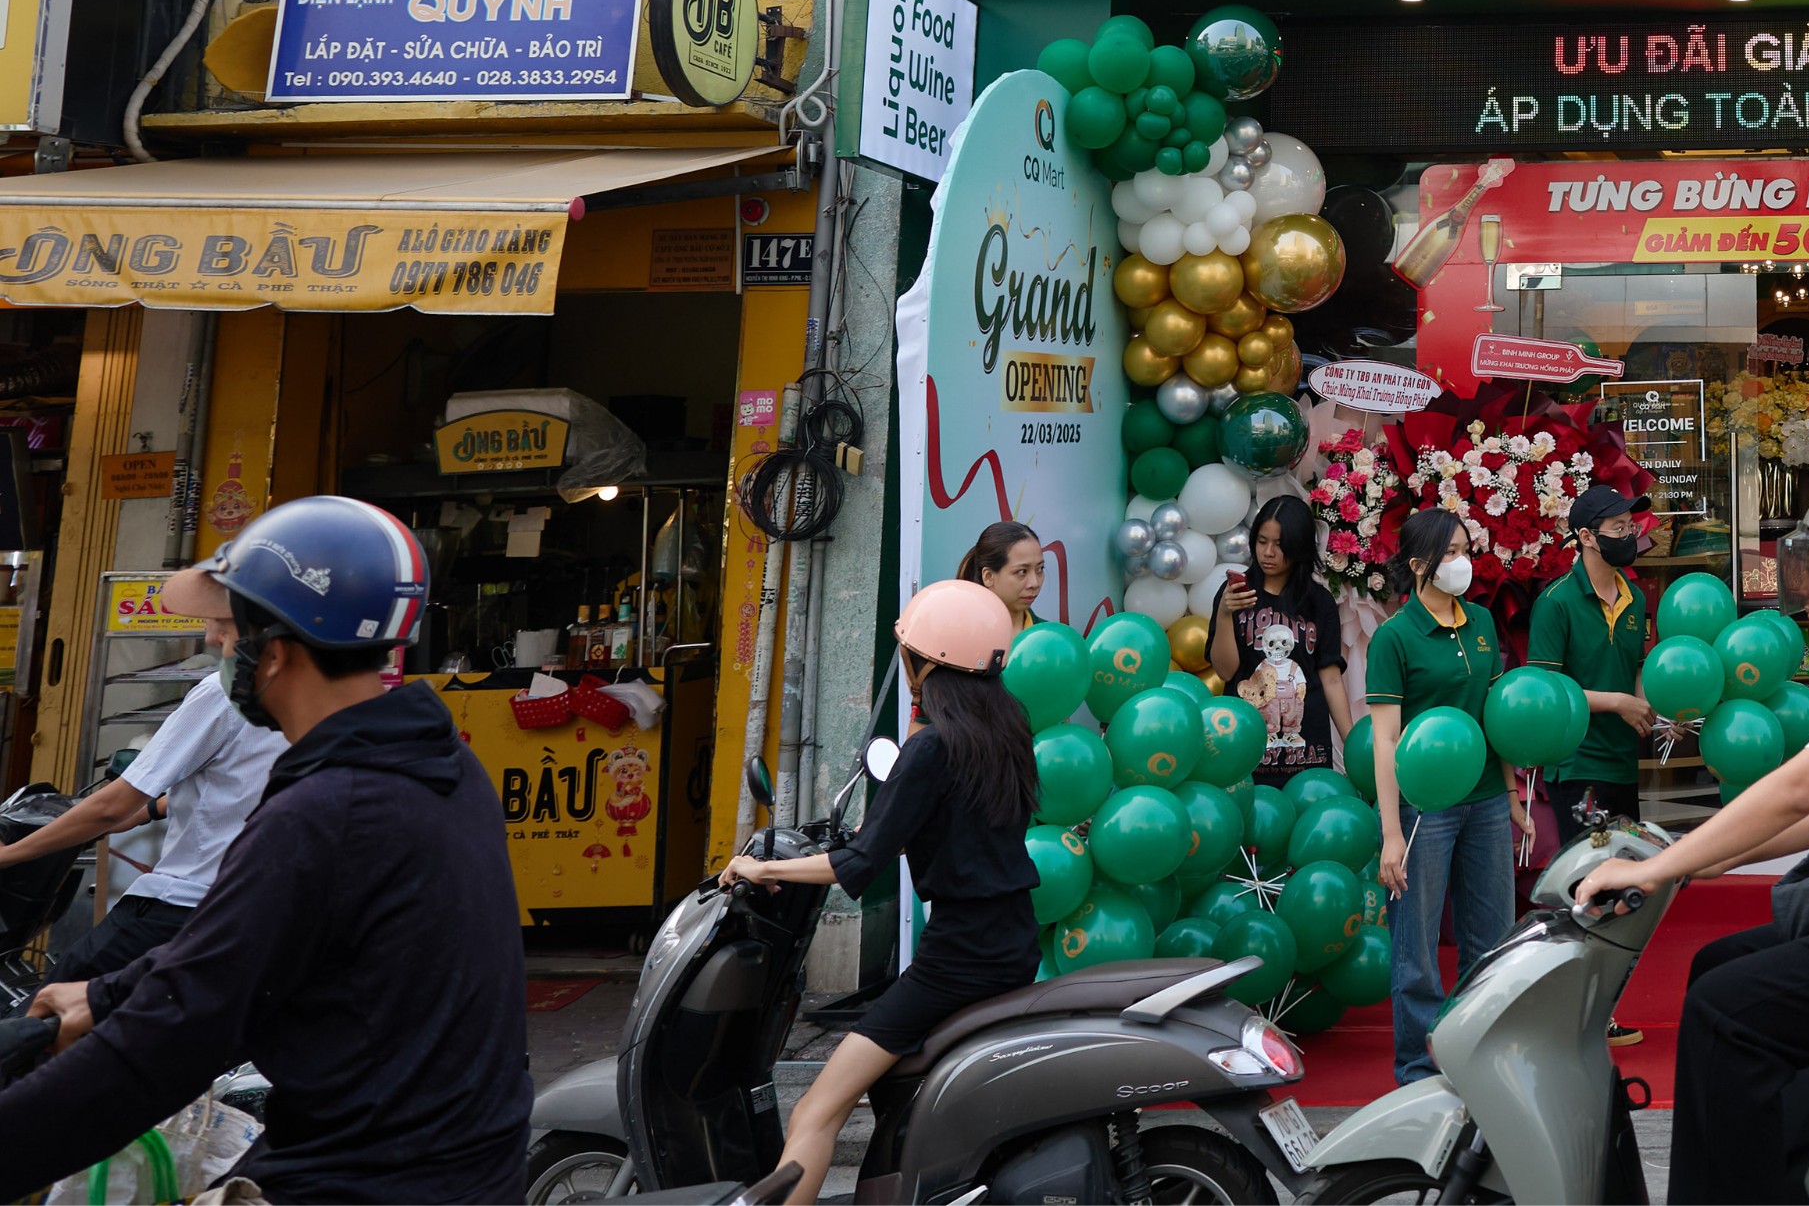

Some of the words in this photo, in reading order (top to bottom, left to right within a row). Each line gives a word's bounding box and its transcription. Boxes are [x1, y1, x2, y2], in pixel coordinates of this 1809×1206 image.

[305, 34, 343, 61] LẮP
[346, 34, 386, 63] ĐẶT
[403, 33, 445, 60] SỬA
[450, 35, 509, 60] CHỮA
[528, 33, 572, 59] BẢO
[575, 33, 603, 58] TRÌ
[1554, 34, 1630, 76] ƯU
[1645, 24, 1729, 74] ĐÃI
[285, 70, 314, 88] Tel
[328, 70, 458, 88] 090.393.4640
[476, 67, 618, 87] 028.3833.2954
[908, 49, 956, 106] Wine
[1475, 86, 1540, 135] ÁP
[1556, 92, 1691, 139] DỤNG
[905, 106, 946, 157] Beer
[1023, 154, 1041, 185] CQ
[1041, 160, 1065, 191] Mart
[1547, 174, 1663, 213] TƯNG
[1673, 170, 1799, 212] BỪNG
[0, 225, 183, 285] ÔNG
[196, 221, 386, 280] BẦU
[397, 222, 439, 254] ALÔ
[490, 223, 552, 255] HÀNG
[1644, 225, 1714, 255] GIẢM
[1716, 224, 1770, 254] ĐẾN
[389, 260, 449, 296] 0977
[452, 260, 498, 296] 786
[500, 261, 545, 296] 046
[973, 224, 1098, 374] Grand
[1537, 352, 1560, 360] GROUP
[1005, 359, 1090, 405] OPENING
[1345, 368, 1356, 380] TY
[1371, 372, 1382, 384] AN
[1020, 421, 1082, 446] 22/03/2025
[1623, 417, 1695, 433] ELCOME
[123, 459, 157, 471] OPEN
[1654, 459, 1682, 469] DAILY
[1658, 474, 1698, 484] SUNDAY
[1681, 490, 1693, 499] PM
[503, 746, 608, 823] BẦU
